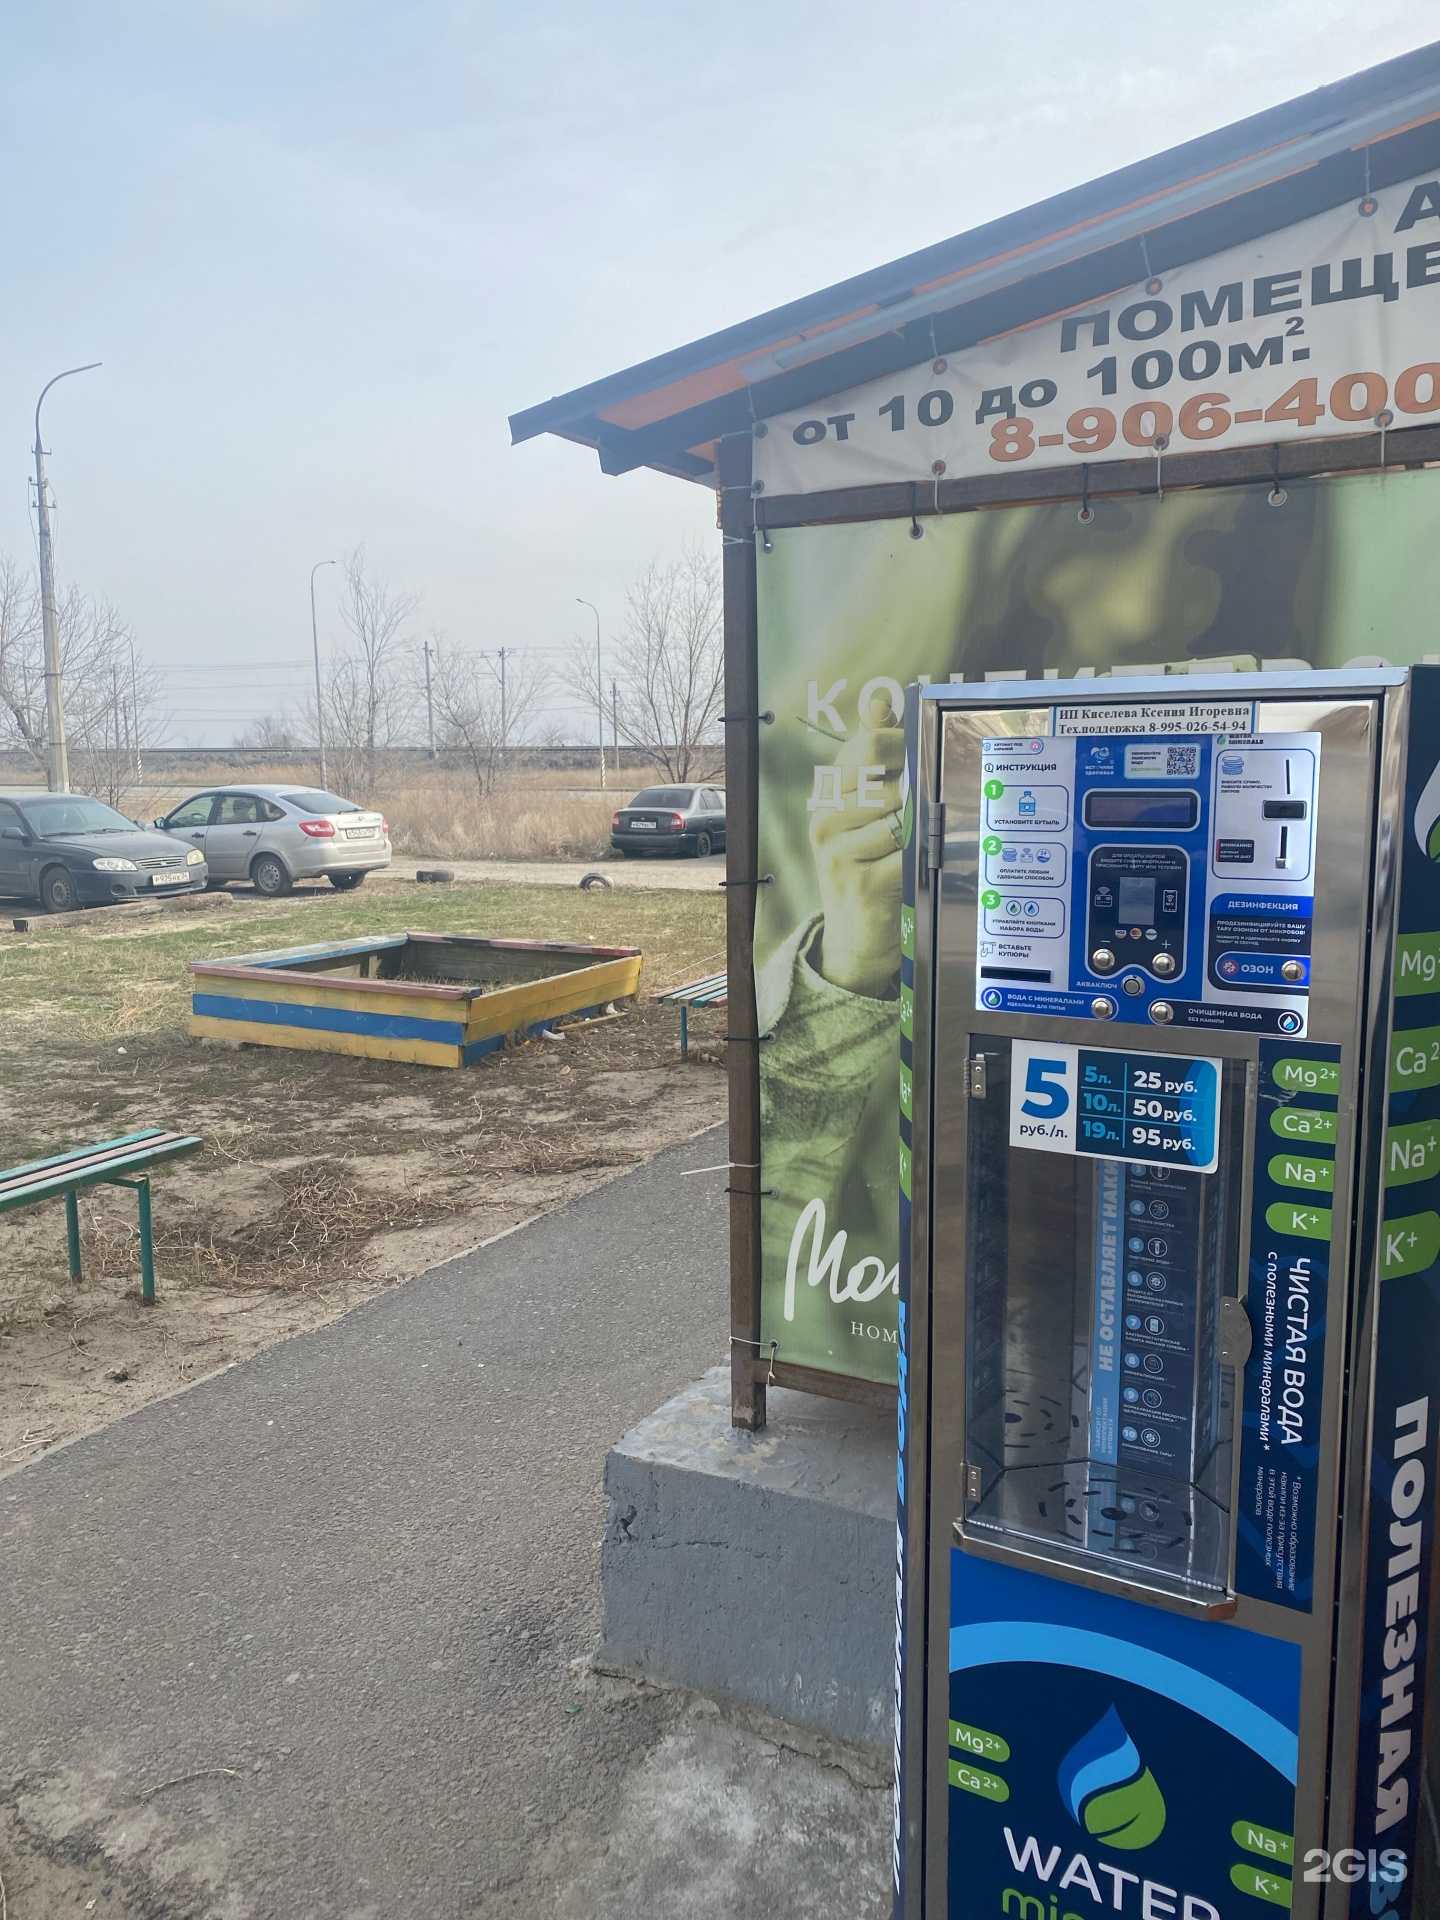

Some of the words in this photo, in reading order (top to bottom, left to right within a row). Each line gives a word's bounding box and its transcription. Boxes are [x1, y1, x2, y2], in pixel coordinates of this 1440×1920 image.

[878, 389, 954, 432] 10
[1059, 709, 1078, 720] ИП
[1082, 707, 1137, 719] Киселева
[1141, 706, 1185, 718] Ксения
[1189, 706, 1250, 718] Игоревна
[1059, 723, 1145, 735] Тех.поддержка
[1149, 721, 1246, 733] 8-995-026-54-94
[996, 763, 1057, 771] ИНСТРУКЦИЯ
[990, 785, 996, 795] 1
[988, 840, 997, 851] 2
[986, 894, 996, 905] 3
[1228, 900, 1298, 910] ДЕЗИНФЕКЦИЯ
[998, 943, 1032, 951] ВСТАВЬТЕ
[1241, 964, 1274, 974] ОЗОН
[1401, 948, 1440, 982] Mg
[1076, 981, 1118, 989] АКВАКЛЮЧ
[1007, 993, 1027, 1001] ВОДА
[1034, 996, 1085, 1005] МИНЕРАЛАМИ
[1188, 1008, 1238, 1018] ОЧИЩЕННАЯ
[1239, 1012, 1263, 1020] ВОДА
[1021, 1058, 1070, 1120] 5
[1133, 1070, 1162, 1089] 25
[1164, 1079, 1198, 1094] руб.
[1132, 1099, 1162, 1118] 50
[1163, 1108, 1197, 1123] руб.
[1019, 1124, 1068, 1139] руб./л.
[1132, 1127, 1161, 1146] 95
[1162, 1136, 1196, 1151] руб.
[1268, 1251, 1278, 1259] с
[1100, 1221, 1117, 1341] ОСТАВЛЯЕТ
[1263, 1262, 1278, 1347] полезными
[1285, 1257, 1311, 1363] ЧИСТАЯ
[1099, 1344, 1113, 1371] НЕ
[1259, 1350, 1273, 1441] минералами
[1277, 1369, 1305, 1445] ВОДА
[1254, 1466, 1264, 1516] минералов
[1268, 1477, 1276, 1499] этой
[1265, 1499, 1275, 1522] воде
[1278, 1505, 1286, 1530] из-за
[1290, 1481, 1302, 1530] Возможно
[1275, 1531, 1285, 1589] присутствия
[1288, 1531, 1299, 1591] образование
[1376, 1396, 1429, 1835] ПОЛЕЗНАЯ
